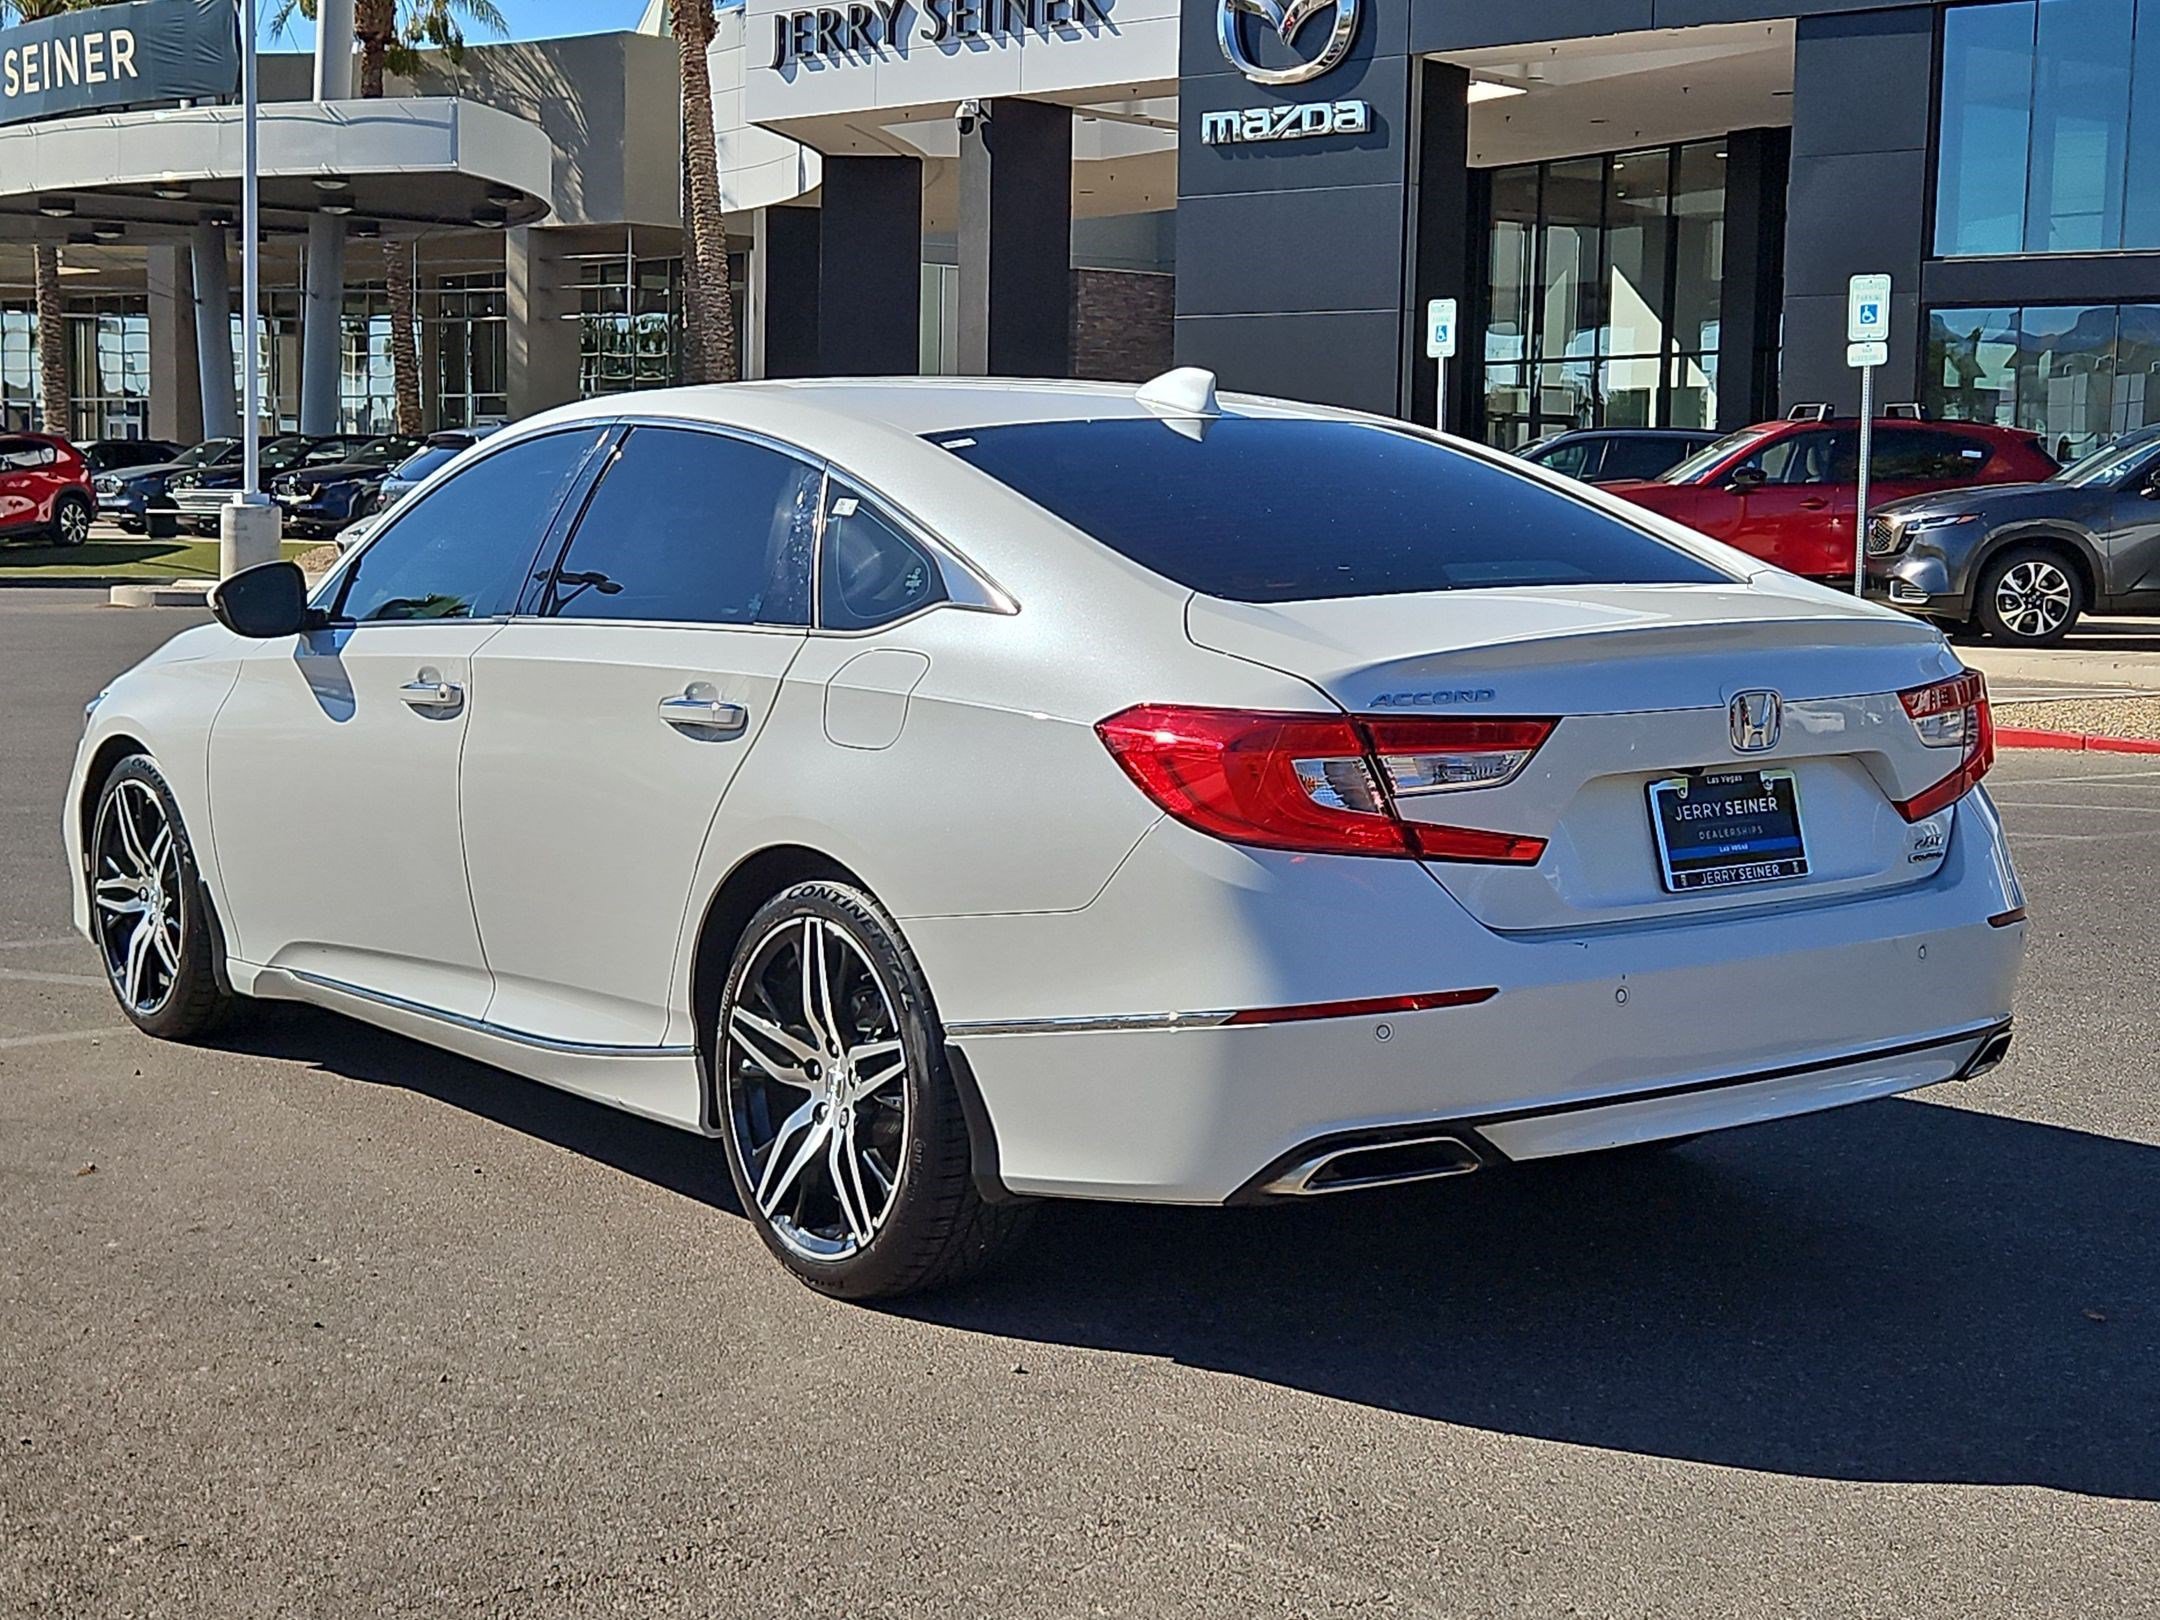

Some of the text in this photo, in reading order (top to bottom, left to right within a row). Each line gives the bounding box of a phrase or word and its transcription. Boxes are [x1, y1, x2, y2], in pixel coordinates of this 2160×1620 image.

[768, 0, 906, 70] JERRY
[4, 29, 138, 98] SEINER
[1368, 688, 1496, 708] ACCORD
[1706, 774, 1742, 785] Las Vegas
[1675, 797, 1778, 821] JERRY SEINER
[1698, 825, 1763, 840] DEALERSHIPS
[1700, 864, 1781, 885] JERRY SEINER
